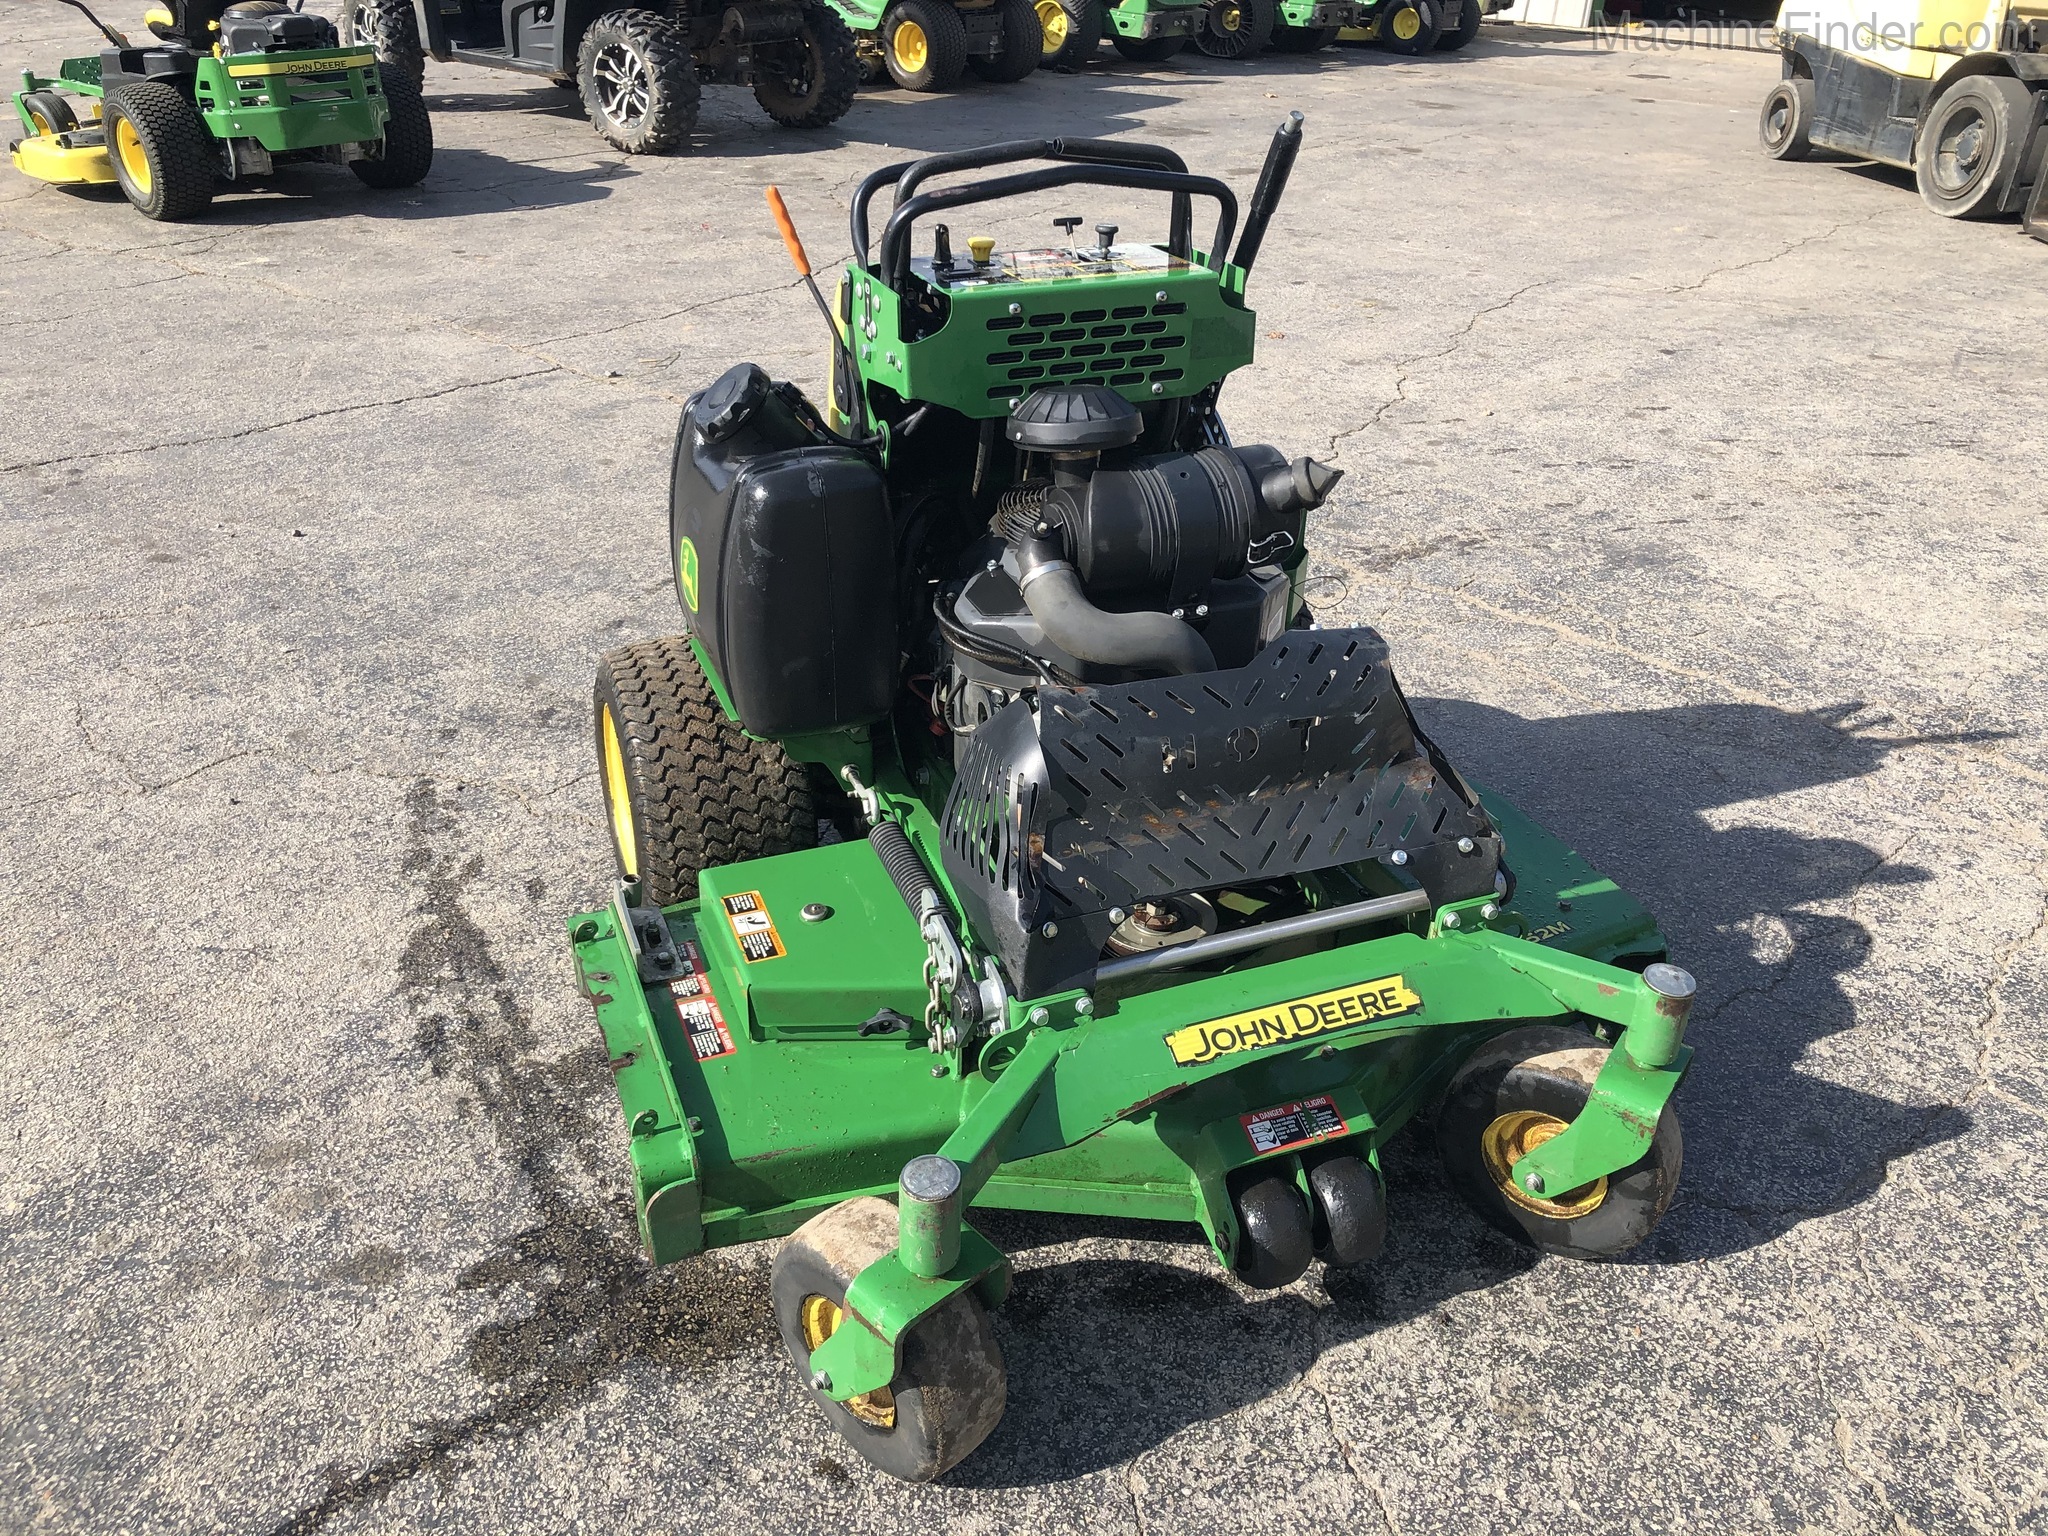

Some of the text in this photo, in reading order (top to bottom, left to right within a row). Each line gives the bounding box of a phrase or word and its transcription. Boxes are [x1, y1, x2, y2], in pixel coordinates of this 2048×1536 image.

[285, 60, 347, 73] JOHN DEERE
[1194, 986, 1402, 1058] JOHN DEERE
[1259, 1108, 1285, 1120] DANGER
